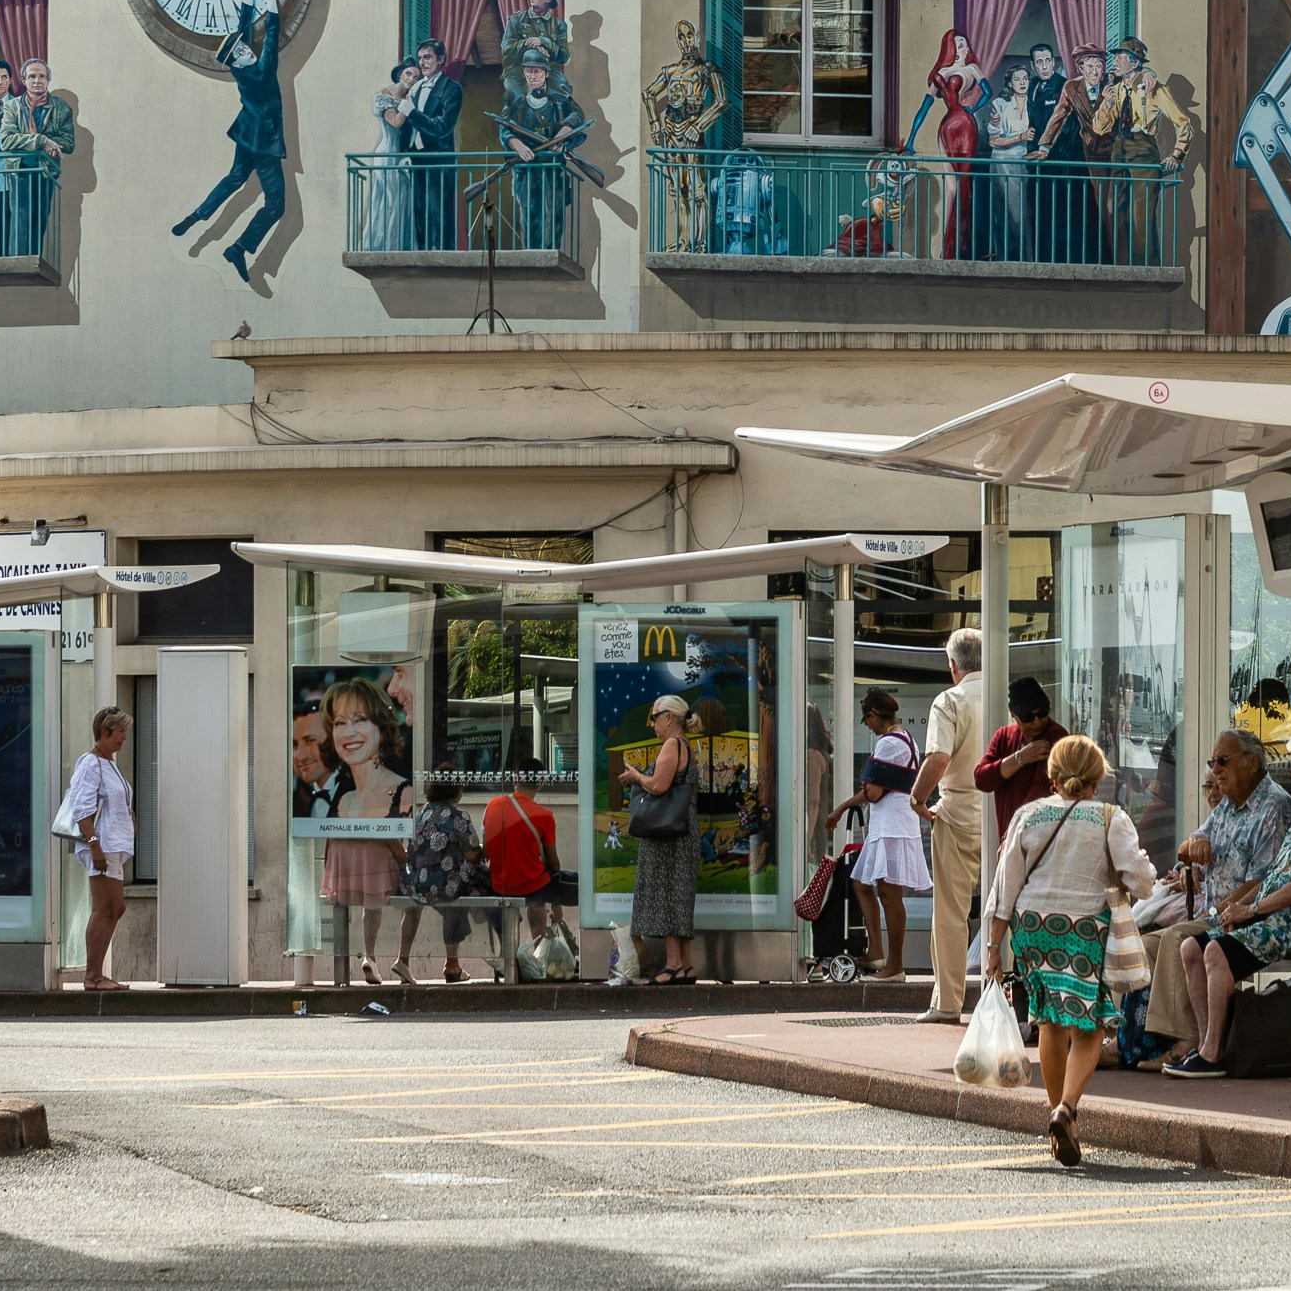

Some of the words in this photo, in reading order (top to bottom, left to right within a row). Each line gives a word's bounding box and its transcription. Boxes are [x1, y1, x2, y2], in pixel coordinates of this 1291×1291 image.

[865, 539, 879, 551] Hôtel
[880, 540, 887, 552] de
[887, 541, 898, 553] Ville
[115, 571, 133, 583] Hôtel
[133, 572, 142, 583] de
[142, 572, 156, 584] Ville
[1083, 584, 1114, 596] TARA
[20, 600, 62, 617] CANNES
[663, 605, 706, 614] JCDecaux
[602, 621, 628, 631] venez
[601, 630, 633, 642] comme
[612, 640, 631, 650] vous
[604, 648, 626, 659] êtes.
[320, 824, 352, 832] NATHALIE
[353, 824, 371, 832] BAYE
[376, 824, 391, 832] 2001
